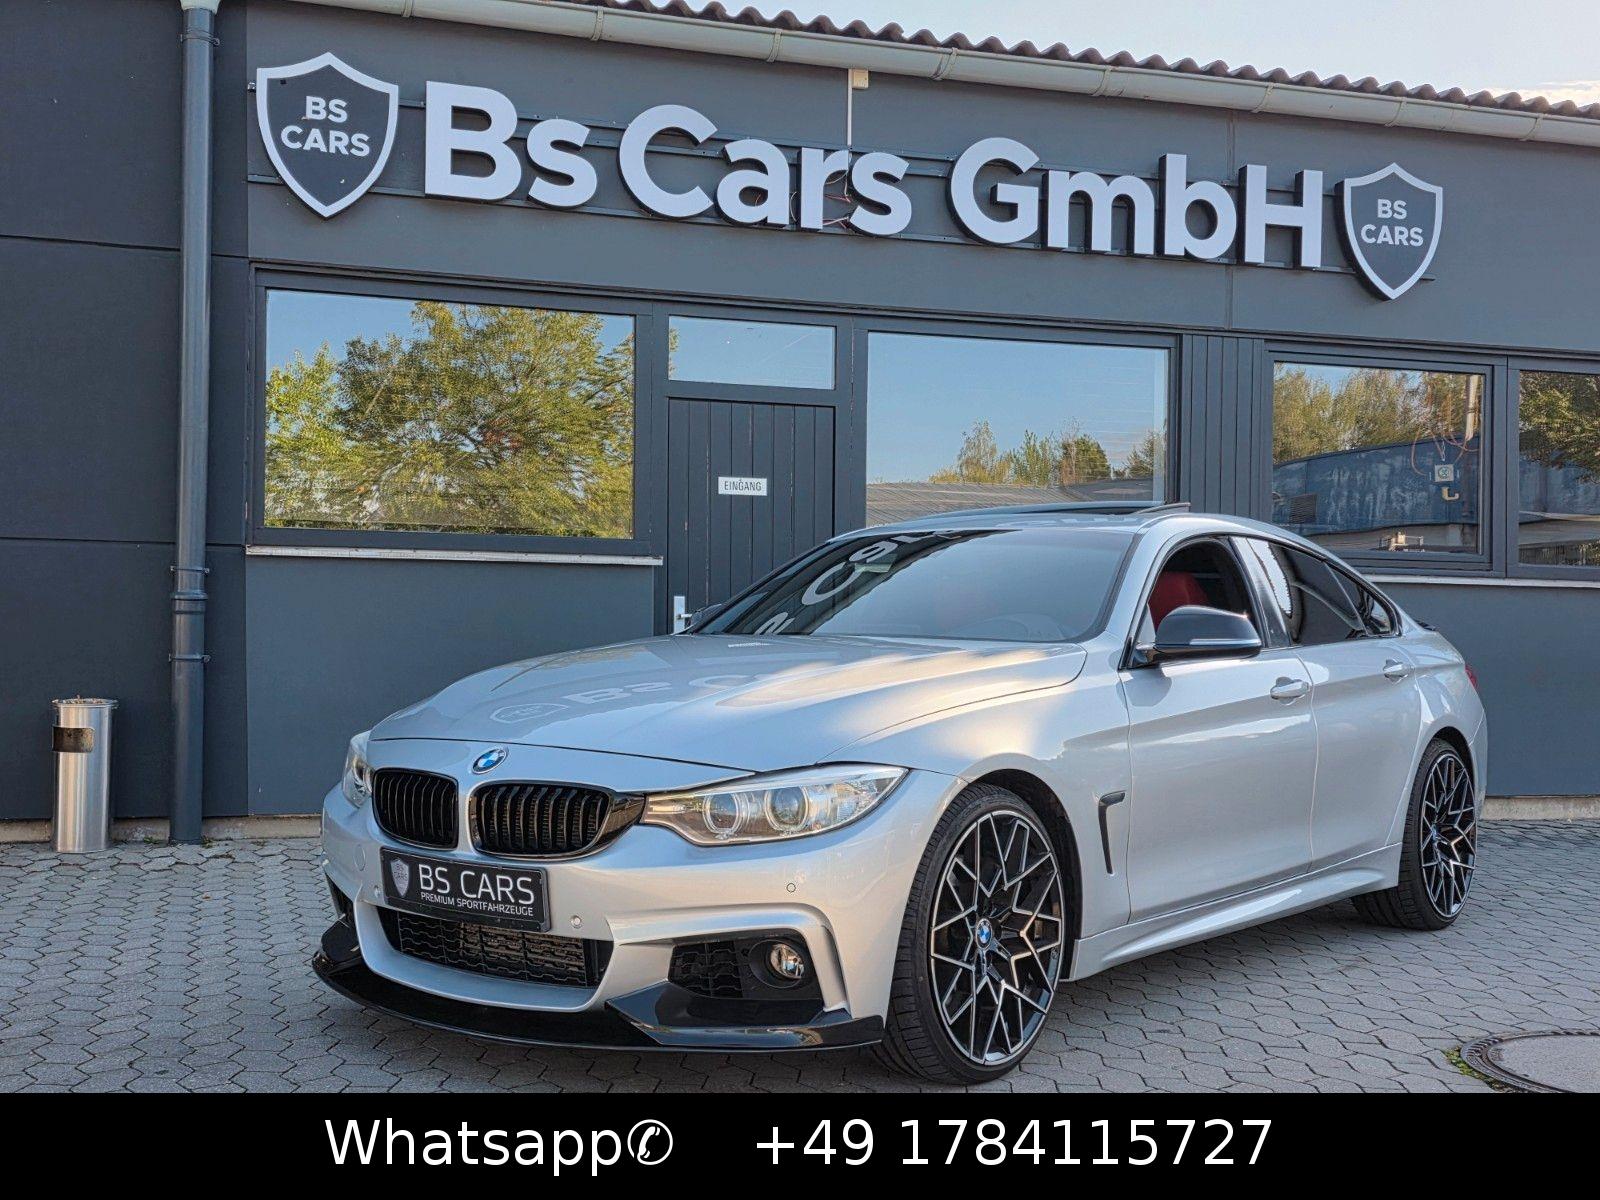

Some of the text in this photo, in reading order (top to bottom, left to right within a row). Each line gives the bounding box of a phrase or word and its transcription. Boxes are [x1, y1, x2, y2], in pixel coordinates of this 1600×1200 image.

[305, 95, 348, 124] BS
[280, 125, 371, 158] CARS
[949, 136, 1323, 268] GmbH
[1376, 198, 1408, 220] BS
[1361, 223, 1424, 248] CARS
[724, 480, 762, 491] EINGANG
[418, 863, 450, 894] BS
[460, 870, 534, 905] CARS
[420, 891, 534, 917] PREMIUM SPORTFAHRZEUGE
